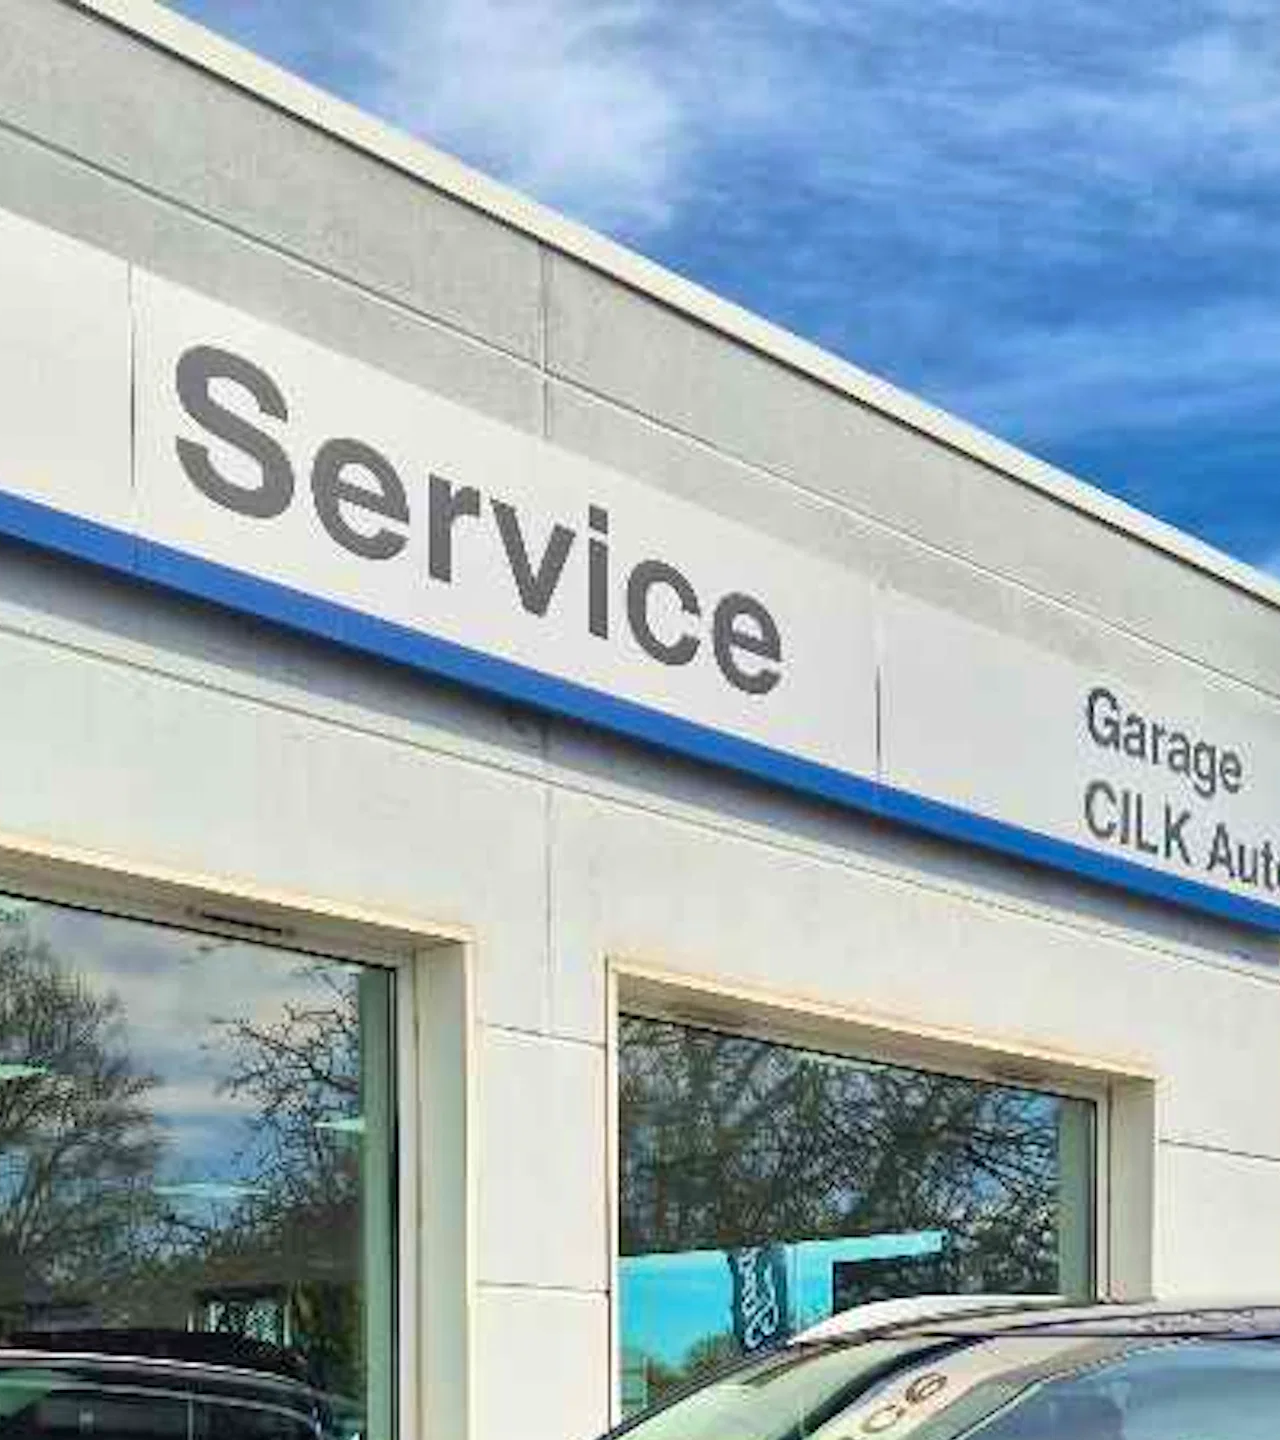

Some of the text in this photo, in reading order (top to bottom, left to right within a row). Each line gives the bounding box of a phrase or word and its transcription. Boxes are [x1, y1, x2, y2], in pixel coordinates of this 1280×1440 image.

[175, 344, 783, 695] Service
[1086, 686, 1243, 800] Garage
[1084, 779, 1192, 867] CILK
